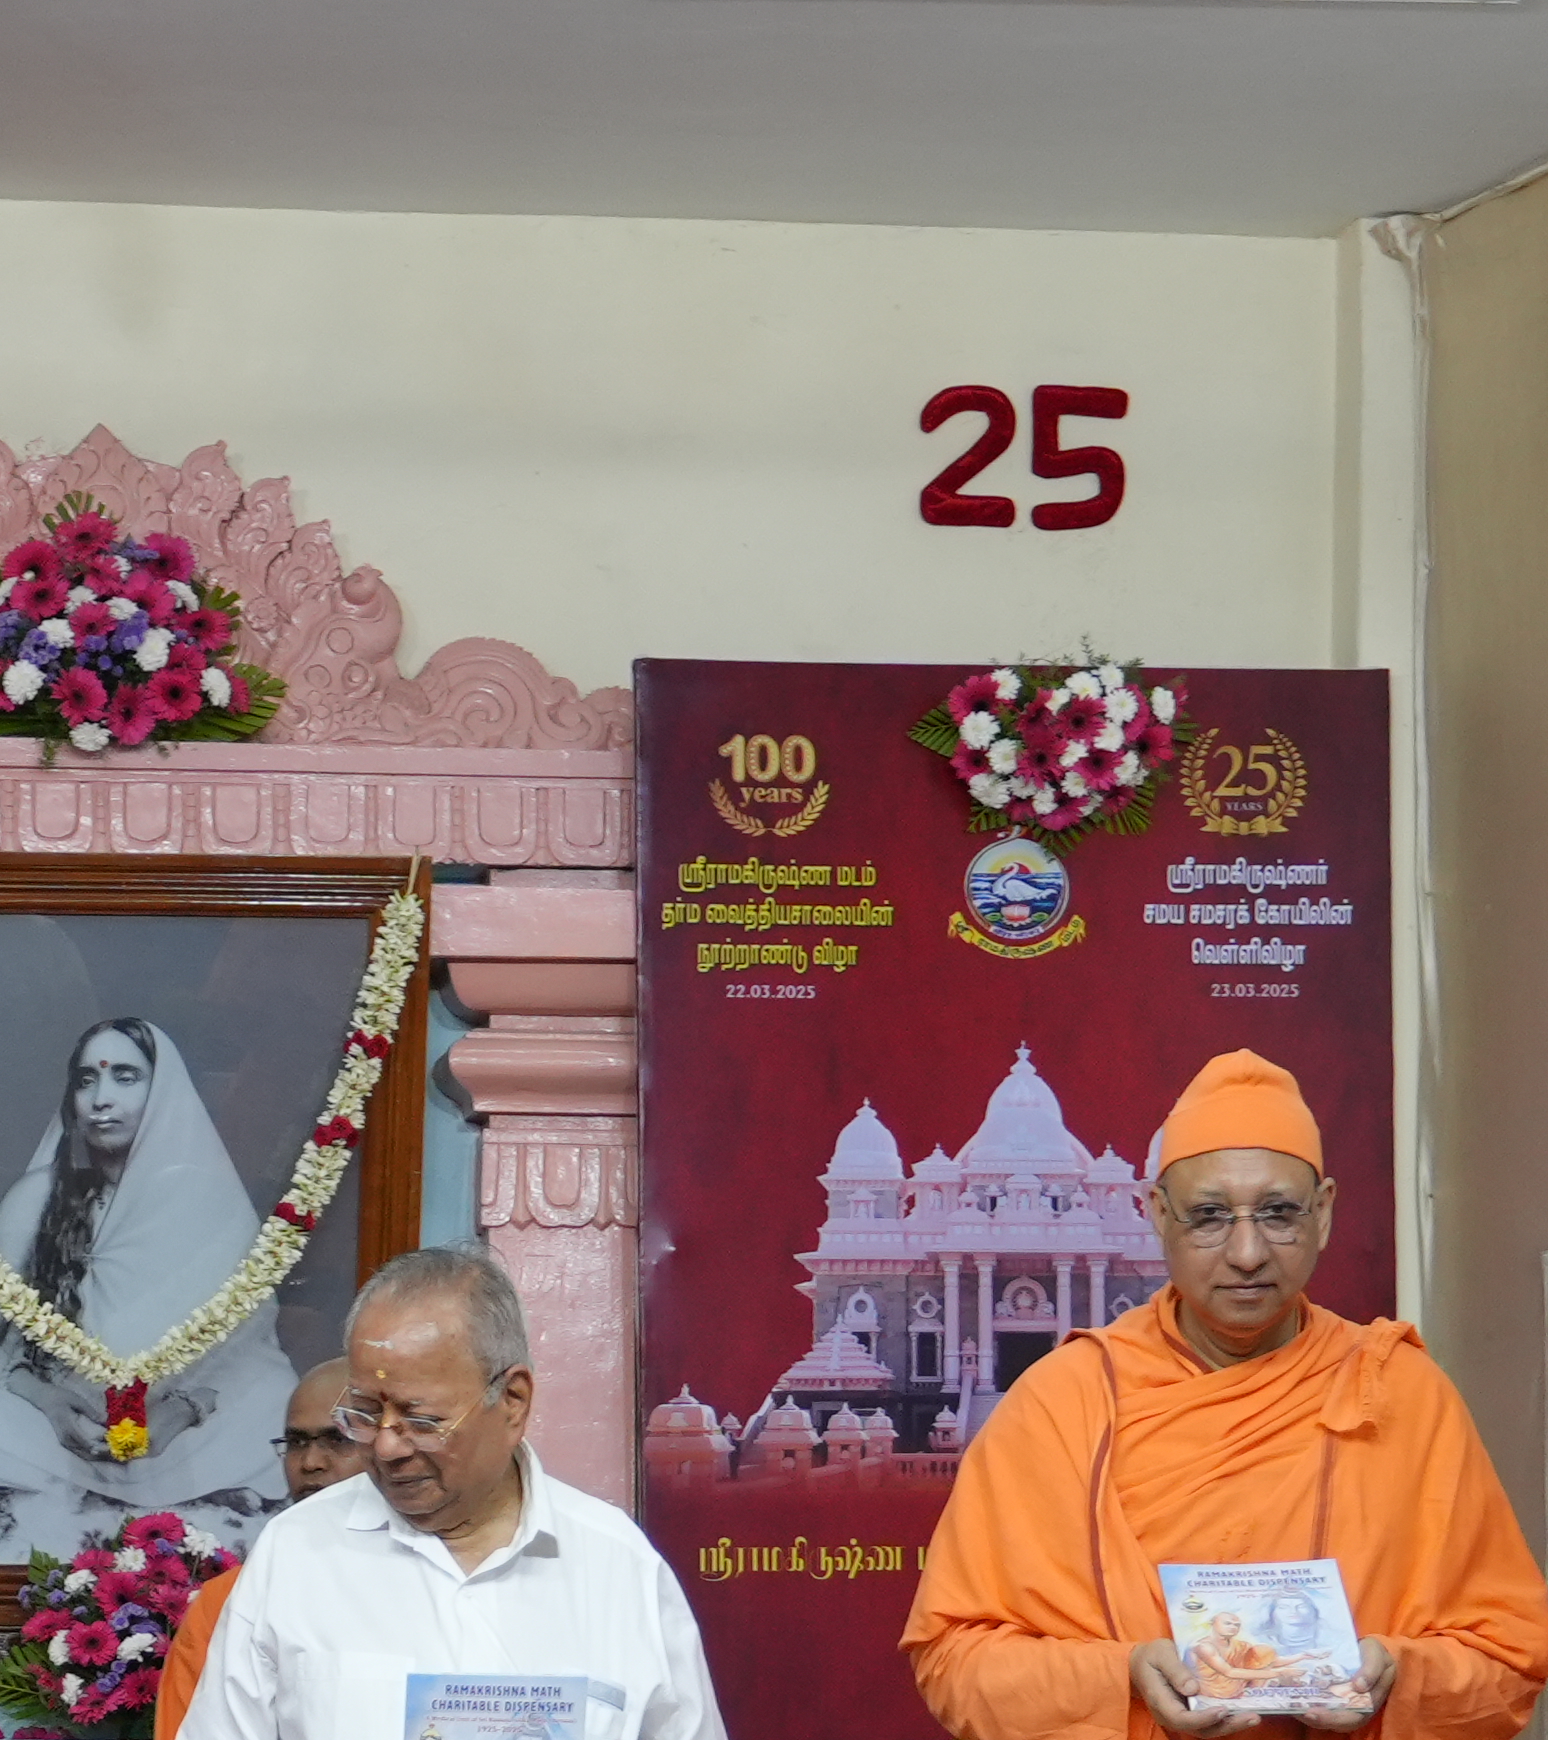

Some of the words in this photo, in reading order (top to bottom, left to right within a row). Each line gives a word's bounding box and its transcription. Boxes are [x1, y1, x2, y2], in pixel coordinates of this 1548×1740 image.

[920, 384, 1129, 531] 25
[718, 733, 816, 784] 100
[1212, 745, 1278, 796] 25
[739, 787, 804, 808] years
[1225, 801, 1264, 811] YEARS
[836, 859, 877, 886] மடம்
[661, 896, 701, 930] தர்ம
[706, 896, 894, 932] வைத்தியசாலையின்
[1143, 903, 1185, 924] சமய
[1254, 897, 1353, 925] கோயிலின்
[696, 938, 808, 974] நூற்றாண்டு
[812, 937, 859, 973] விழா
[1191, 936, 1306, 972] வெள்ளிவிழா
[725, 984, 816, 999] 22.03.2025
[1210, 983, 1300, 998] 23.03.2025
[1187, 1579, 1254, 1587] CHARITABLE
[1258, 1576, 1327, 1586] DISPENSARY
[1197, 1569, 1277, 1578] RAMAKRISHNA
[1281, 1568, 1311, 1576] MATH
[445, 1684, 526, 1697] RAMAKRISHNA
[530, 1686, 561, 1697] MATH
[431, 1699, 500, 1711] CHARITABLE
[504, 1701, 574, 1713] DISPENSARY
